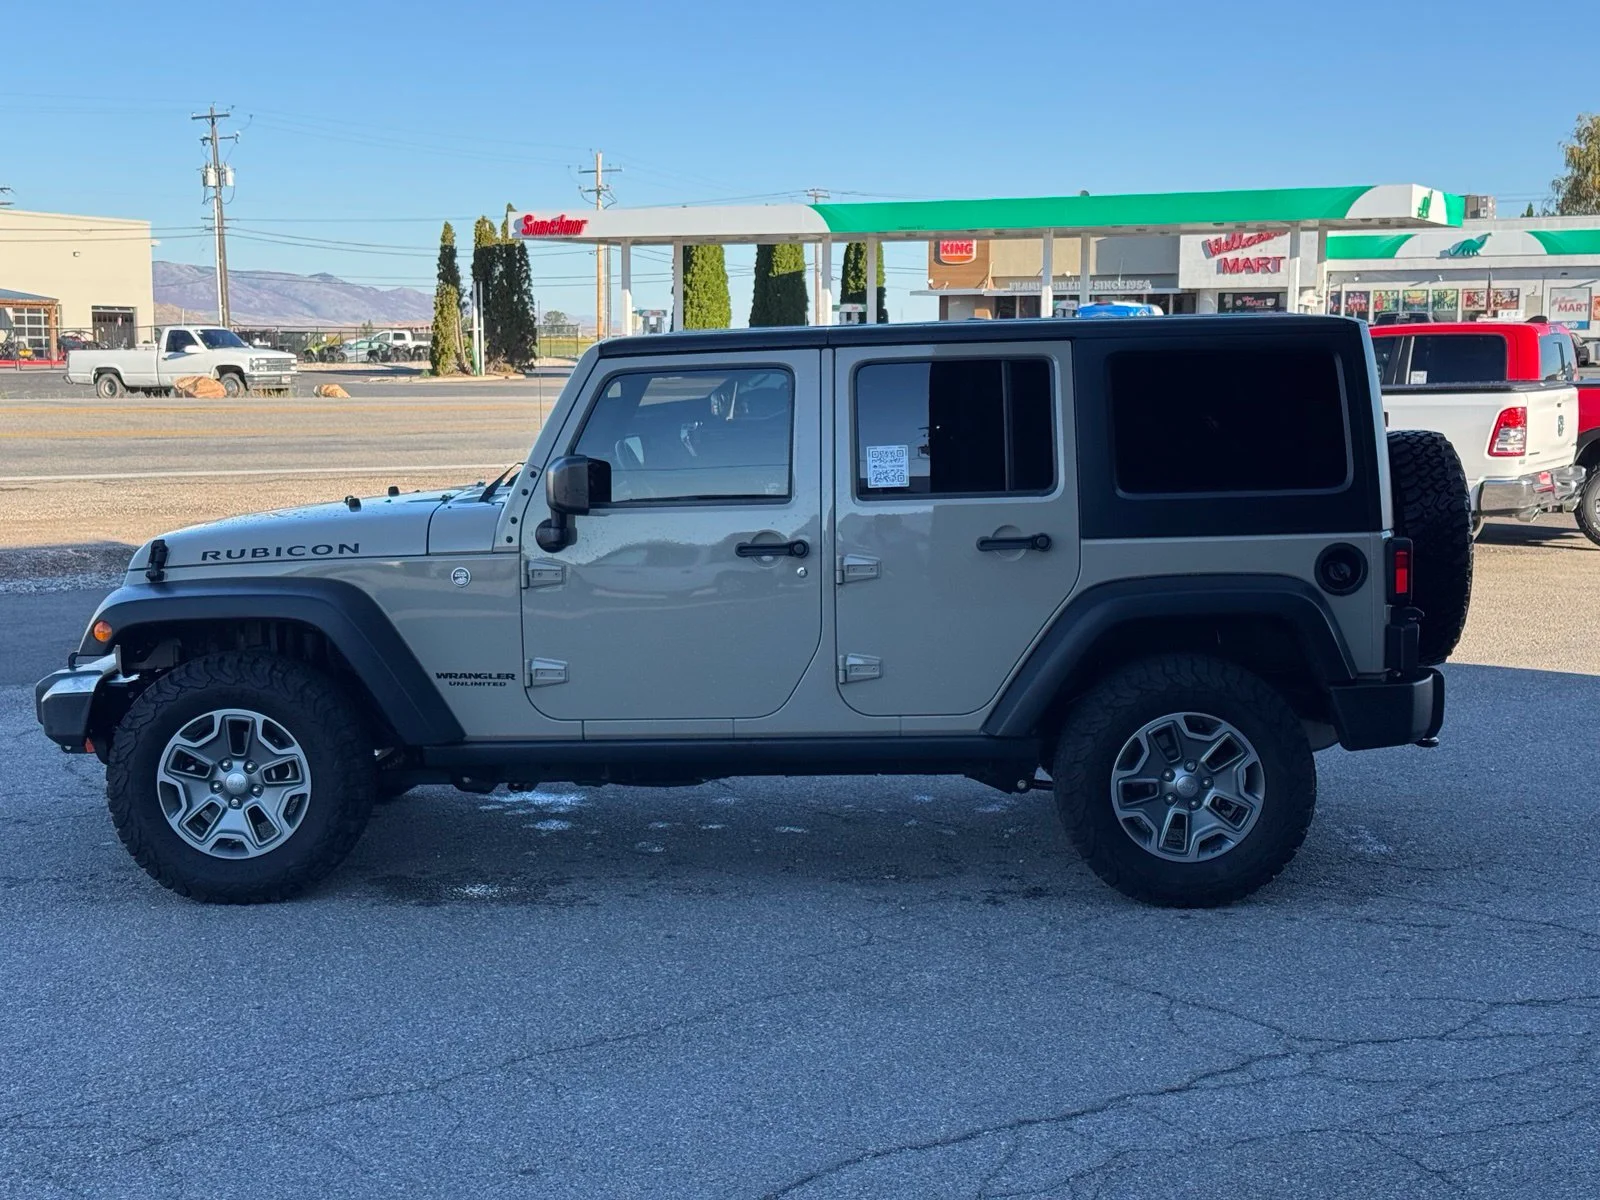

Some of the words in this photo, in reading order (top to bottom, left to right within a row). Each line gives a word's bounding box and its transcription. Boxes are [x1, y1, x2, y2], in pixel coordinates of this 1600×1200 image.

[521, 214, 588, 235] Sinclair
[941, 243, 974, 254] KING
[1222, 256, 1286, 273] MART
[1094, 280, 1125, 290] SINCE
[1126, 279, 1152, 290] 1954
[1557, 303, 1588, 312] MART
[201, 543, 360, 561] RUBICON
[435, 672, 516, 680] WRANGLER
